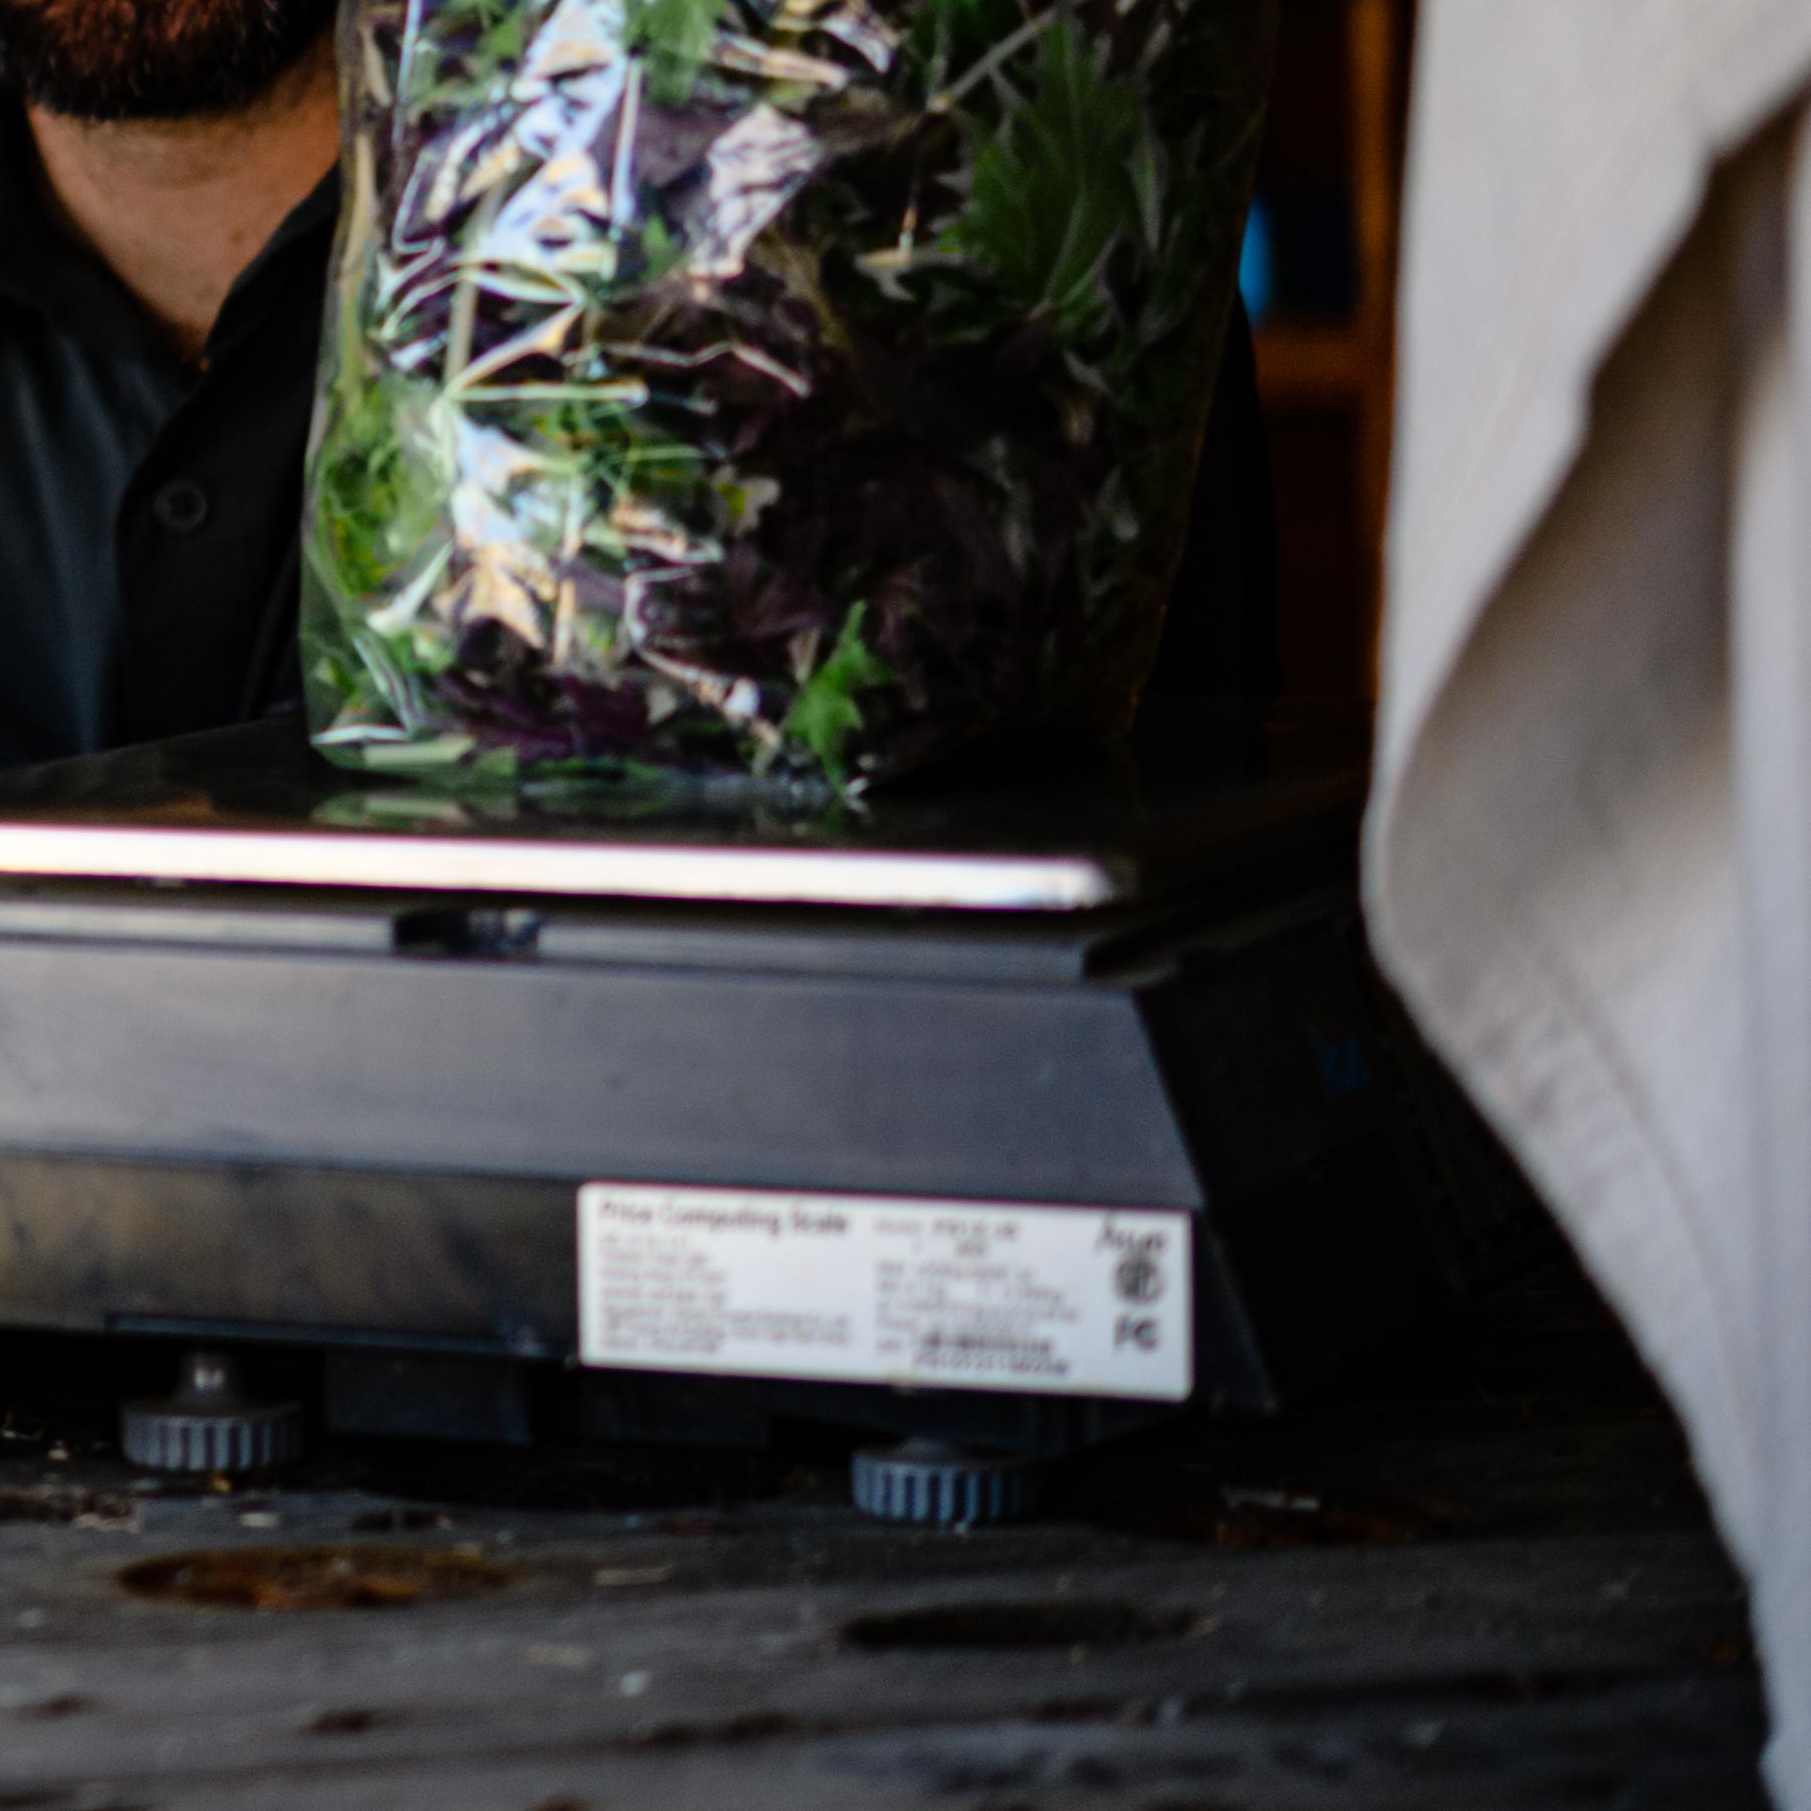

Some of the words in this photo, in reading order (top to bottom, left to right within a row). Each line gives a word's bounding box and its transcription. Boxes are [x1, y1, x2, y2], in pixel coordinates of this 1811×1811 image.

[598, 1198, 653, 1226] Price
[660, 1198, 780, 1238] Computing
[791, 1202, 849, 1234] Scale
